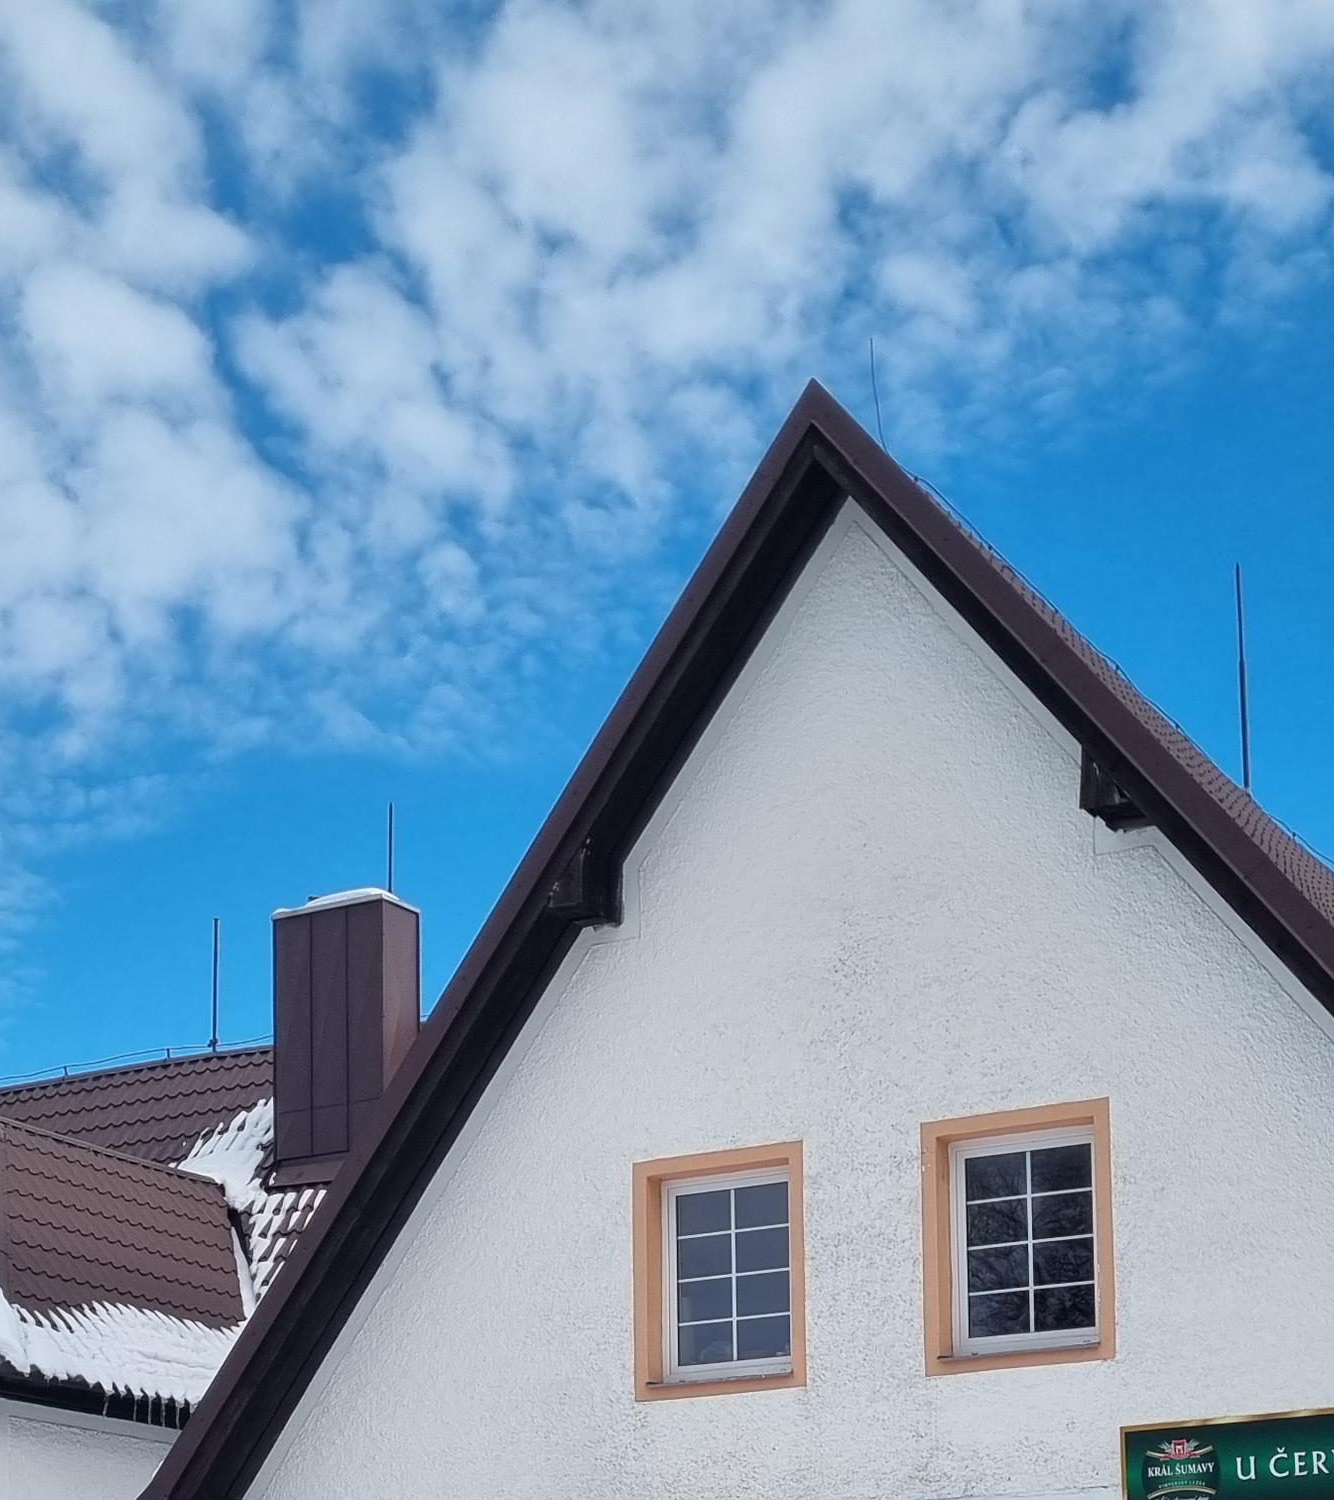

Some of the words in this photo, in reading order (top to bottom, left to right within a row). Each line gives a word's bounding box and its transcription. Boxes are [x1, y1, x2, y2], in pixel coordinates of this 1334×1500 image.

[1148, 1464, 1173, 1478] KRÁL
[1175, 1462, 1215, 1475] ŠUMAVY
[1236, 1455, 1256, 1481] U
